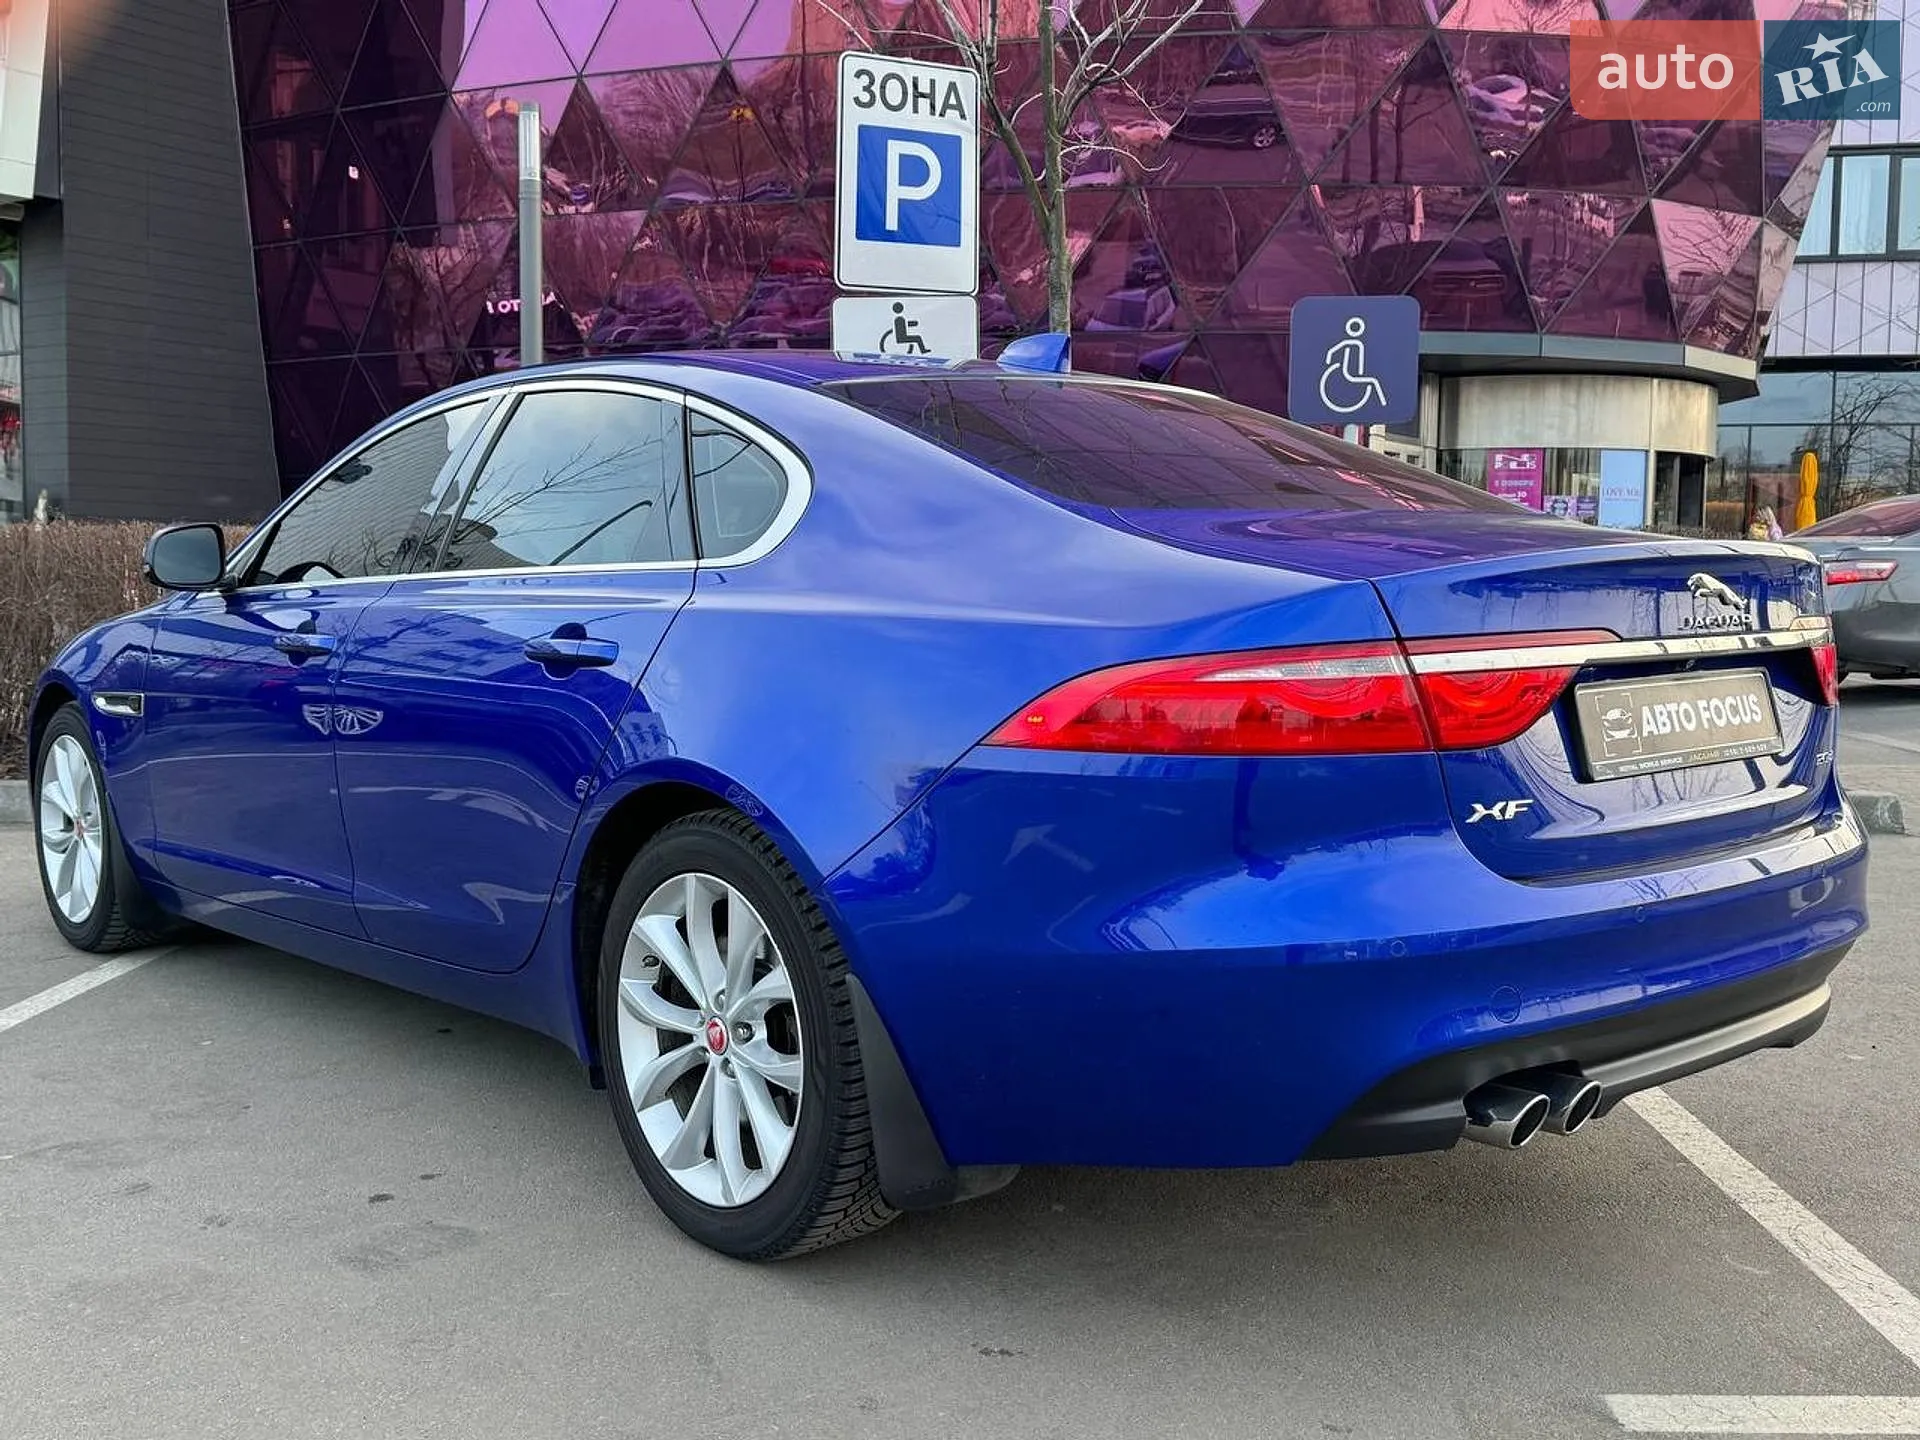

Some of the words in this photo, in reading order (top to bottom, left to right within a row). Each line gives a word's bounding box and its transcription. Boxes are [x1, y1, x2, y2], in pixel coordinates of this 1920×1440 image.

[853, 69, 967, 120] ЗОНА
[885, 139, 942, 231] P
[1680, 613, 1751, 631] JAGUAR
[1642, 701, 1697, 737] АВТО
[1698, 693, 1763, 729] FOCUS
[1465, 799, 1534, 823] XF
